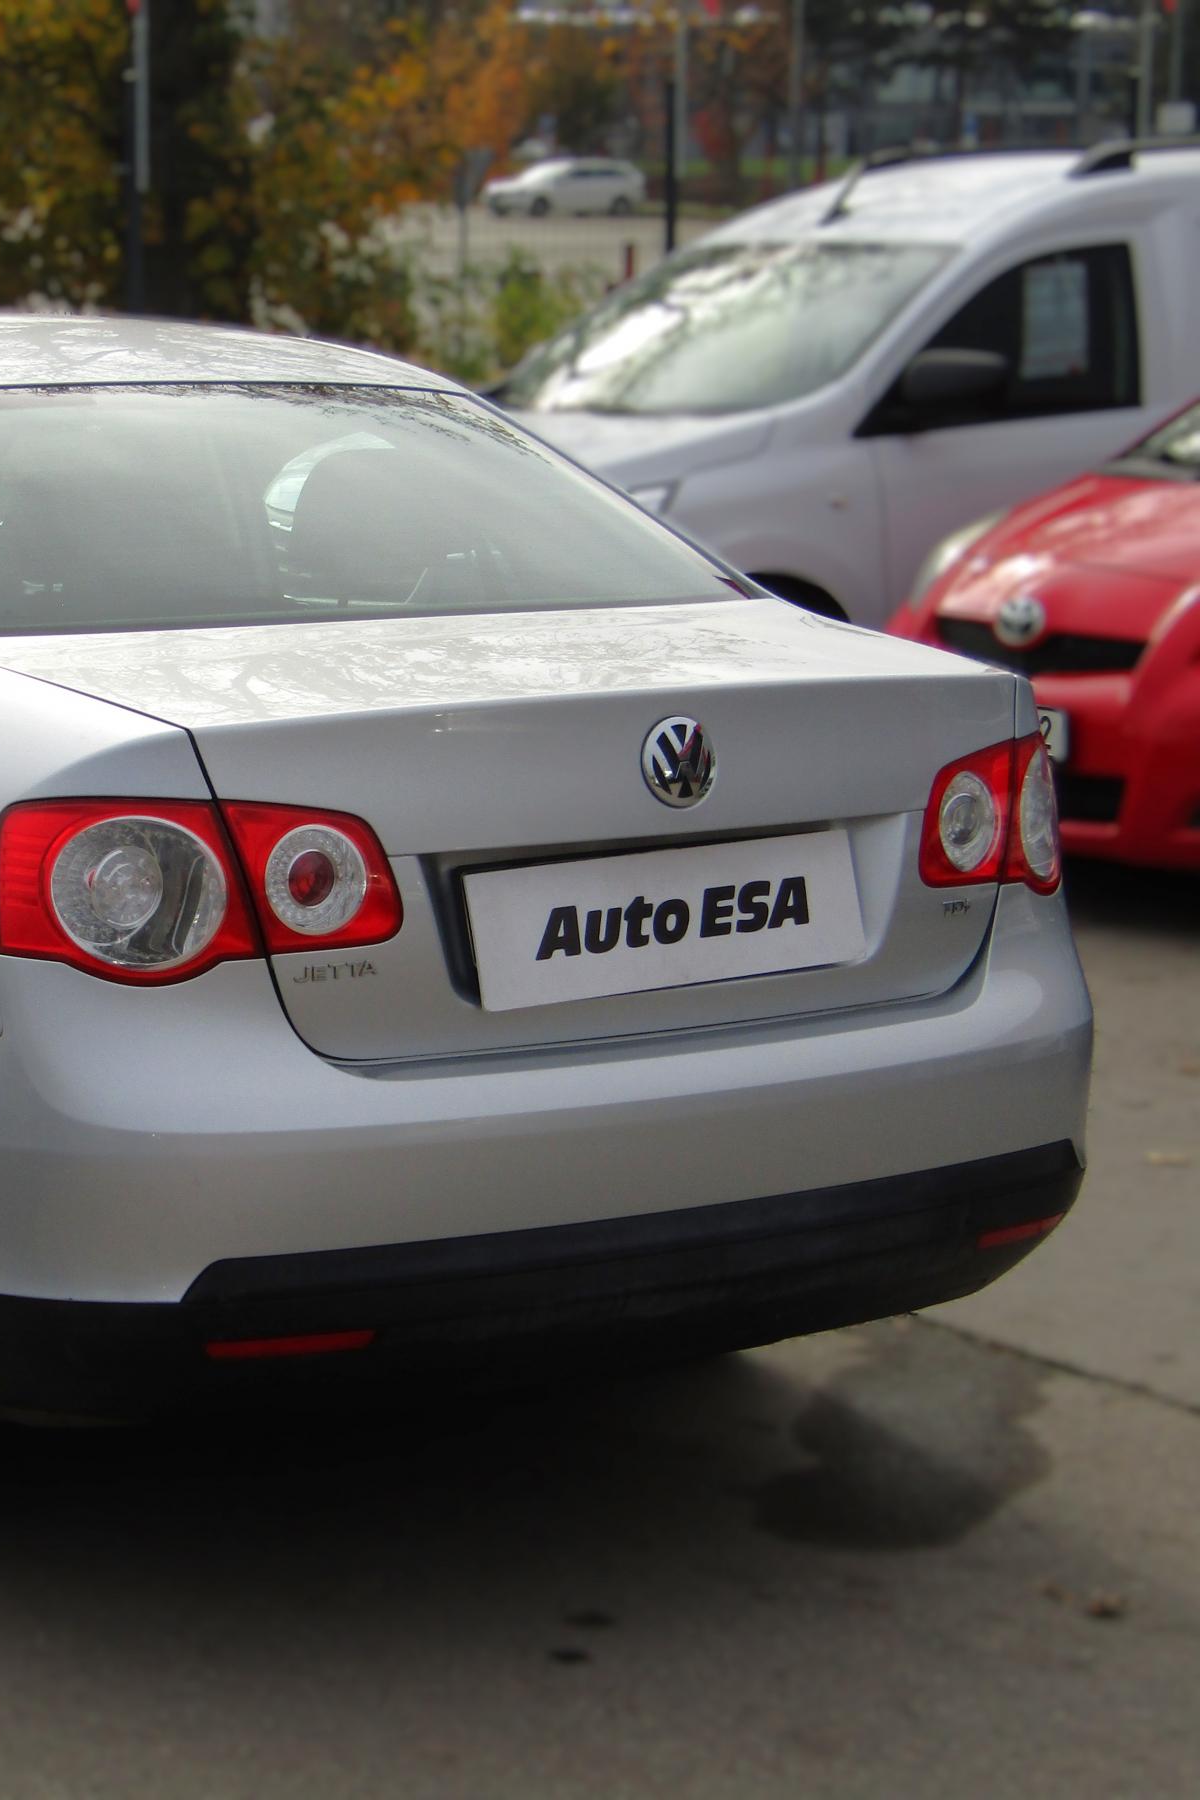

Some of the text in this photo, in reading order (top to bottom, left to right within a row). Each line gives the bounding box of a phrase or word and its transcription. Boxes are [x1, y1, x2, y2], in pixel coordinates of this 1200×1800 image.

[643, 717, 715, 807] VW
[535, 876, 810, 961] Auto ESA
[292, 960, 377, 983] JETTA
